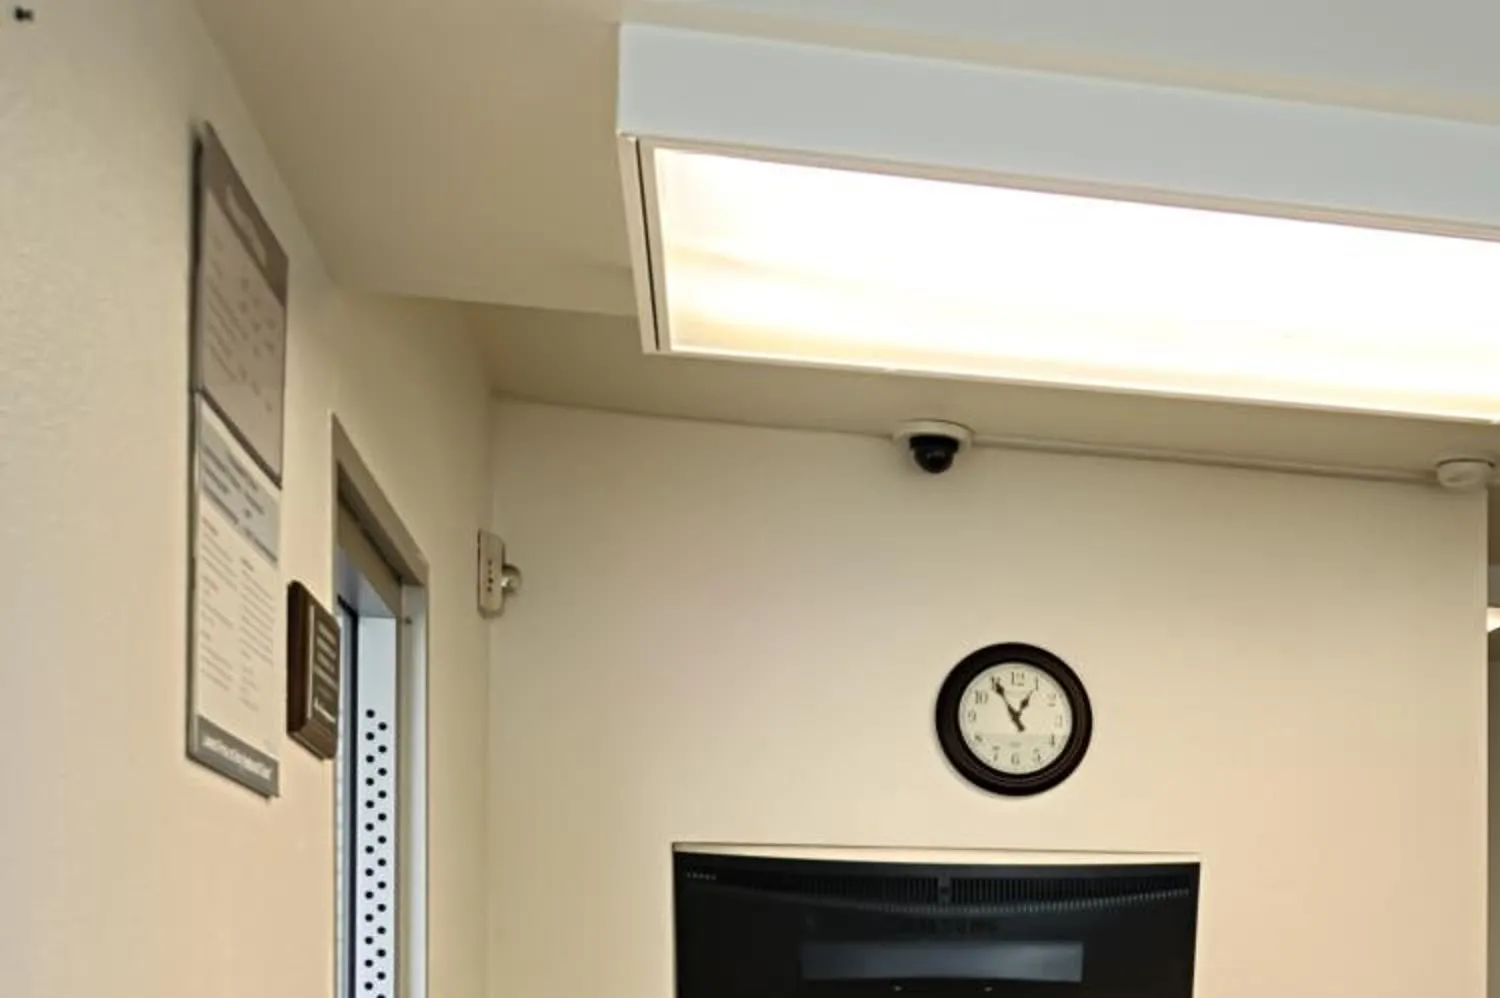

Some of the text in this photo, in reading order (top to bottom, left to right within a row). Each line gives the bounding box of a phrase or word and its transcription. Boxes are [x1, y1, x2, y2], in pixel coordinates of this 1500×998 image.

[1010, 671, 1025, 687] 12
[974, 690, 989, 704] 10
[967, 709, 977, 722] 9
